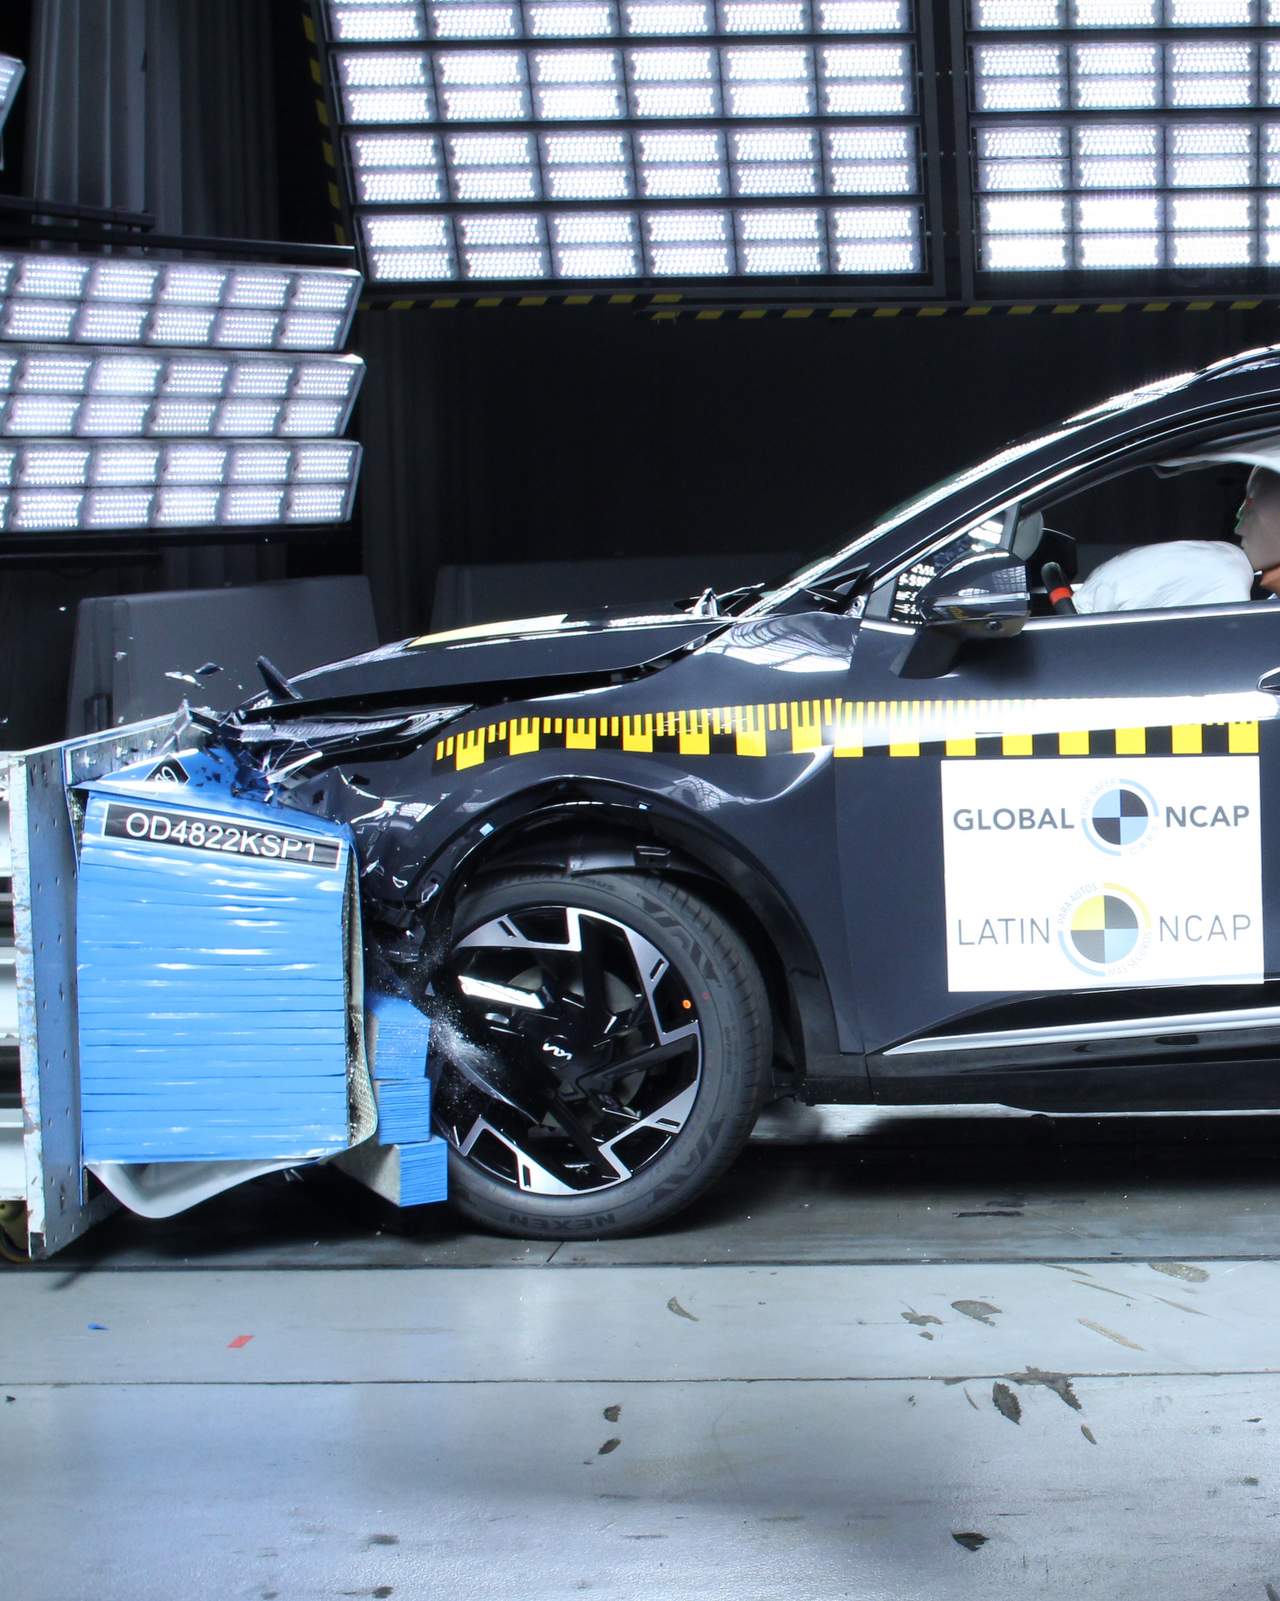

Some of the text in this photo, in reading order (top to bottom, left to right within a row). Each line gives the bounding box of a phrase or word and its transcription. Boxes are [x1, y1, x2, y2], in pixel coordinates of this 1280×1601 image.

[953, 805, 1249, 831] GLOBAL NCAP
[126, 812, 316, 862] OD4822KSP1
[958, 914, 1251, 945] LATIN NCAP
[510, 1213, 616, 1231] NEXEN
